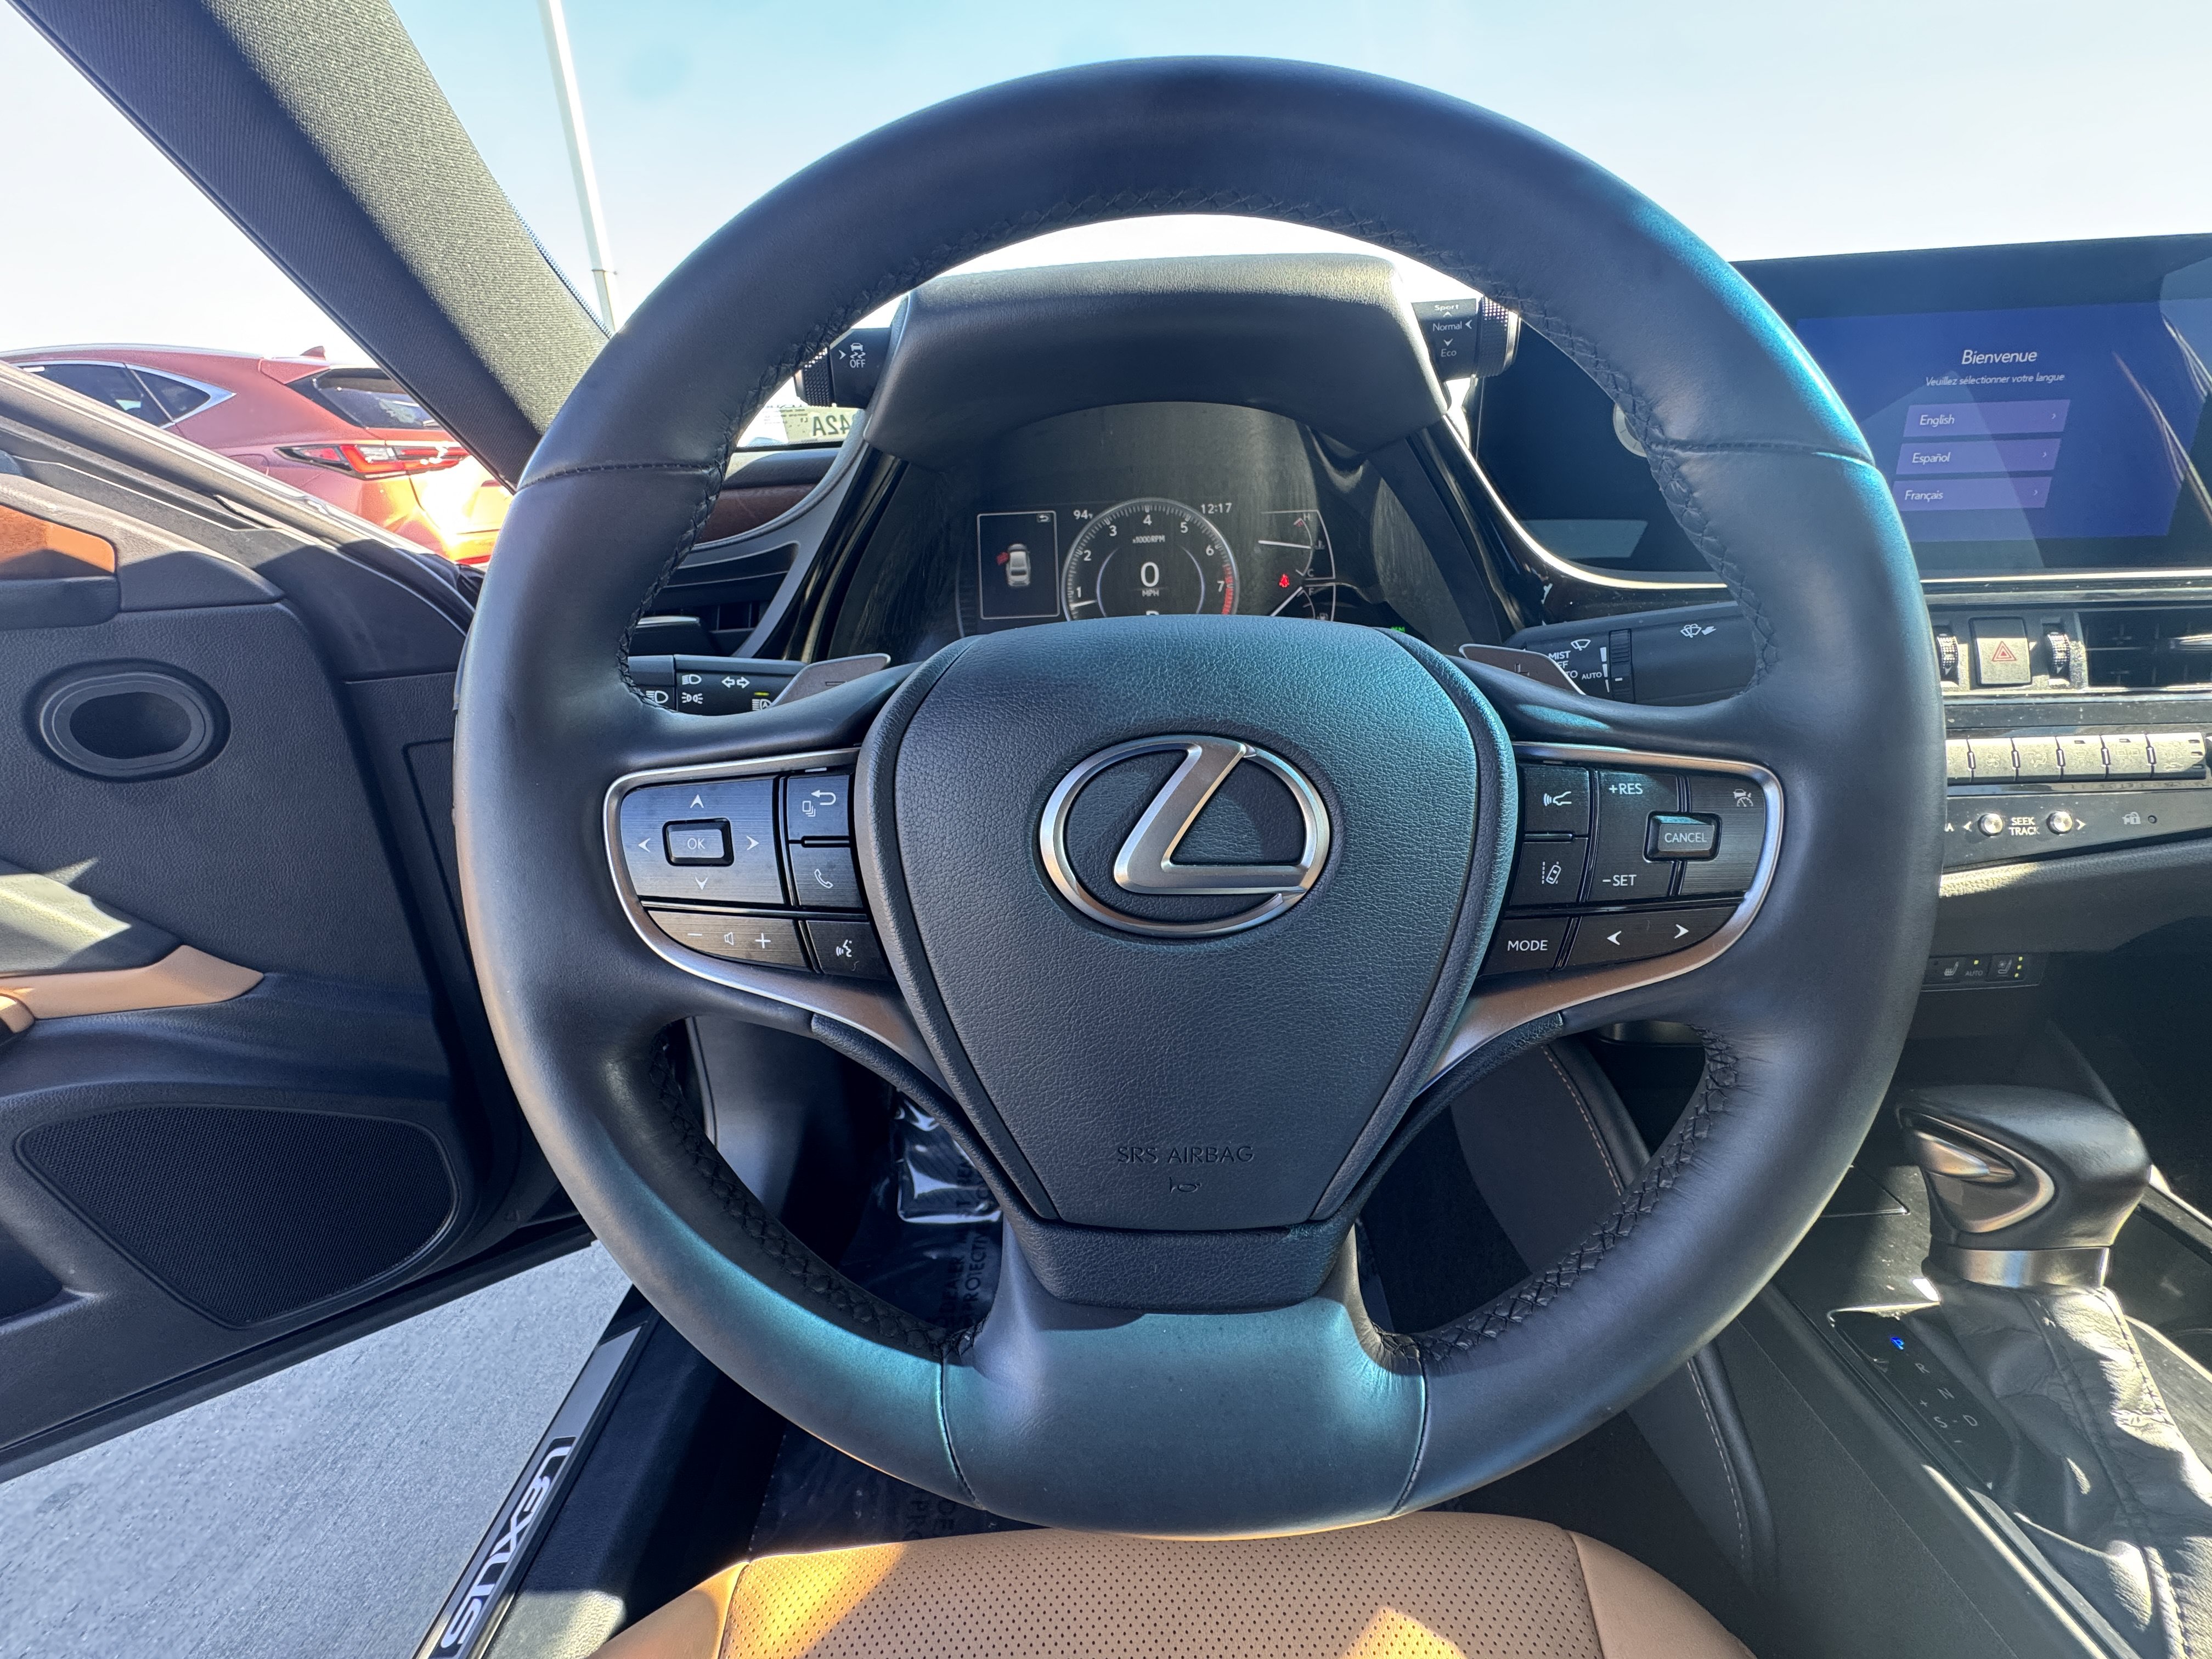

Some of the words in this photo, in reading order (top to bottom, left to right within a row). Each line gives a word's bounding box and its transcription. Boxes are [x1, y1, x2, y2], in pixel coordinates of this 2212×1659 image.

[1432, 321, 1463, 332] Normal
[1440, 349, 1457, 358] Eco
[1961, 349, 2038, 366] Bienvenue
[849, 359, 866, 368] OFF
[1925, 375, 1957, 387] Veuillez
[1959, 373, 2010, 386] sélectionner
[2012, 374, 2034, 383] votre
[2035, 372, 2065, 386] langue
[1919, 413, 1955, 427] English
[1912, 451, 1951, 465] Español
[1904, 488, 1944, 503] Français
[1201, 503, 1232, 514] 12:17
[1143, 515, 1152, 526] 4
[1109, 525, 1117, 537] 3
[1180, 522, 1188, 534] 5
[1083, 550, 1092, 561] 2
[1205, 544, 1215, 556] 6
[1140, 561, 1160, 588] 0
[1075, 586, 1082, 598] 1
[1217, 580, 1224, 592] 7
[1142, 589, 1159, 597] MPH
[1548, 650, 1571, 660] MIST
[1581, 672, 1602, 680] AUTO
[2011, 817, 2035, 826] SEEK
[2008, 825, 2040, 837] TRACK
[687, 837, 706, 850] OK
[1664, 832, 1707, 843] CANCEL
[1507, 940, 1548, 952] MODE
[1117, 1146, 1159, 1164] SRS
[1167, 1145, 1255, 1164] AIRBAG
[1891, 1336, 1904, 1350] P
[1915, 1363, 1930, 1374] R
[1937, 1387, 1955, 1400] N
[1933, 1416, 1948, 1429] S
[1962, 1414, 1978, 1427] D
[441, 1446, 572, 1648] LEXUS
